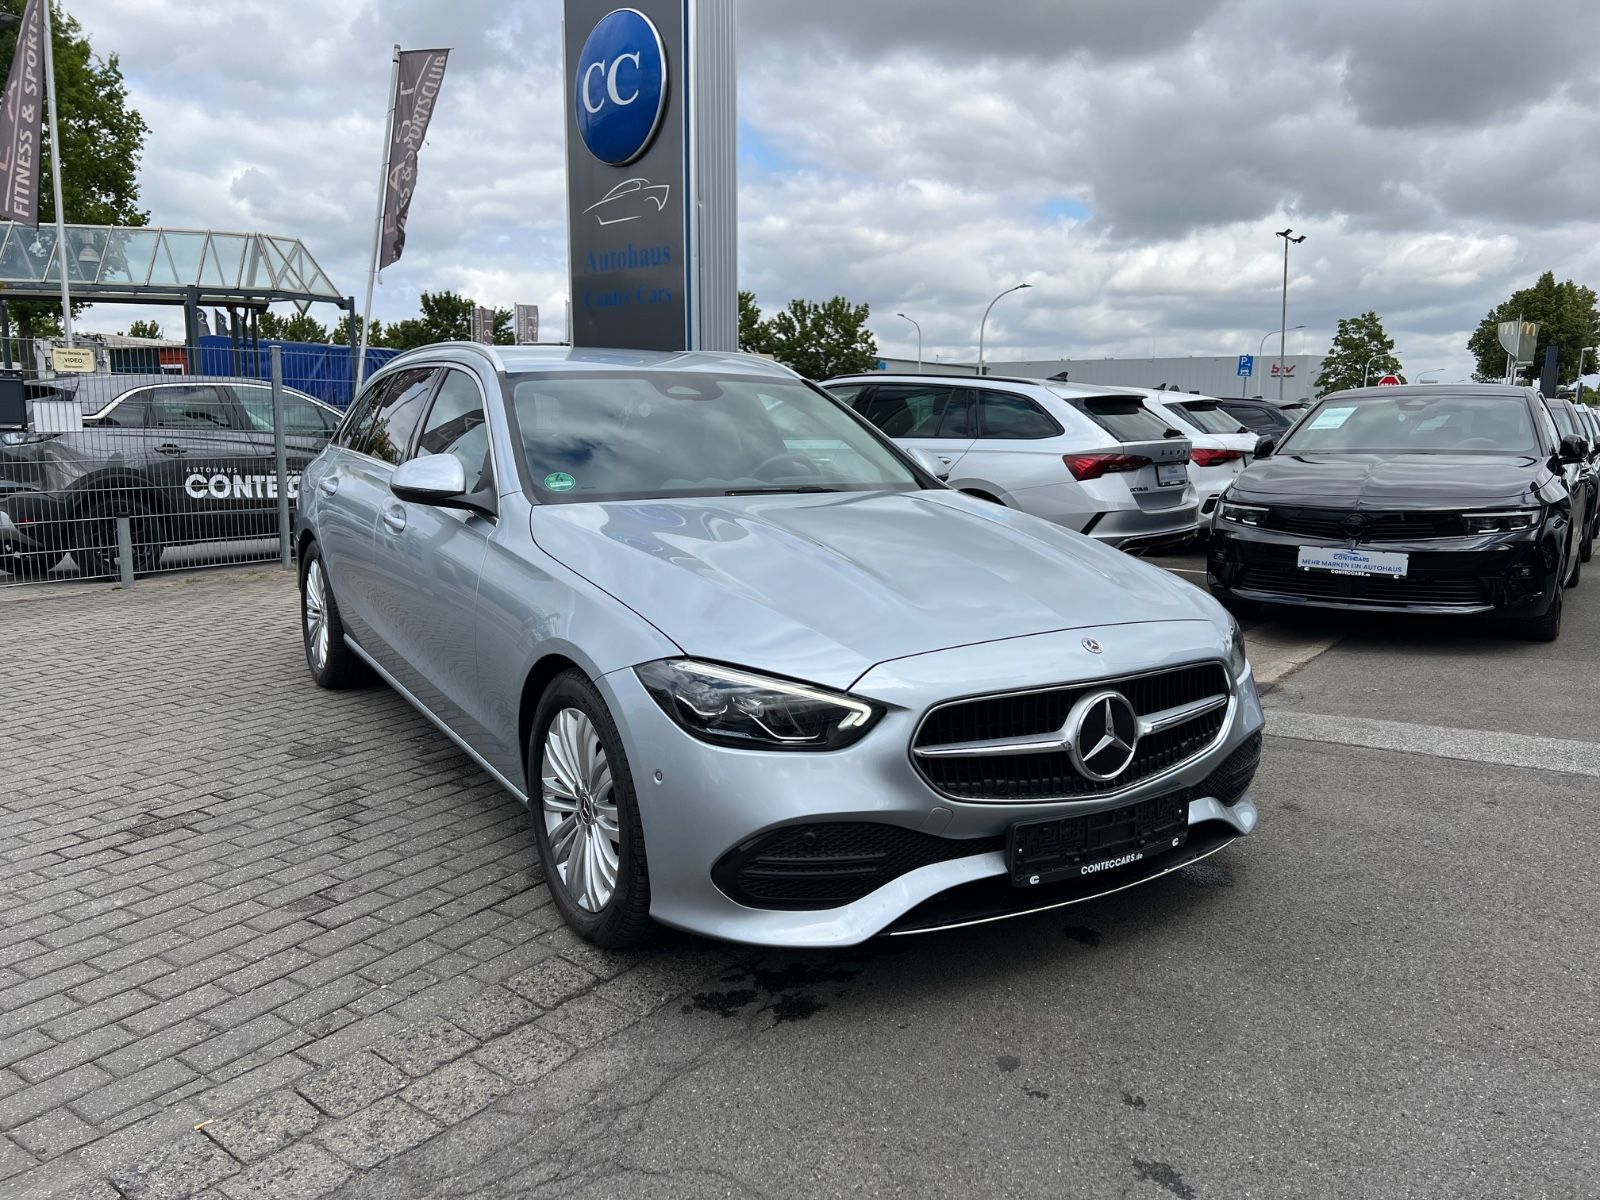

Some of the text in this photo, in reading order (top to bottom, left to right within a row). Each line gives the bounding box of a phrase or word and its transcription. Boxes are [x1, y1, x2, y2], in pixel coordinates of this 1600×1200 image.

[582, 51, 640, 113] CC
[21, 105, 35, 123] &
[13, 128, 33, 217] FITNESS
[583, 242, 672, 273] Autohaus
[186, 466, 238, 474] AUTOHAUS
[1321, 560, 1349, 568] MARKEN
[1363, 564, 1402, 572] AUTOHAUS
[1080, 852, 1143, 875] CONTECCARS.de
